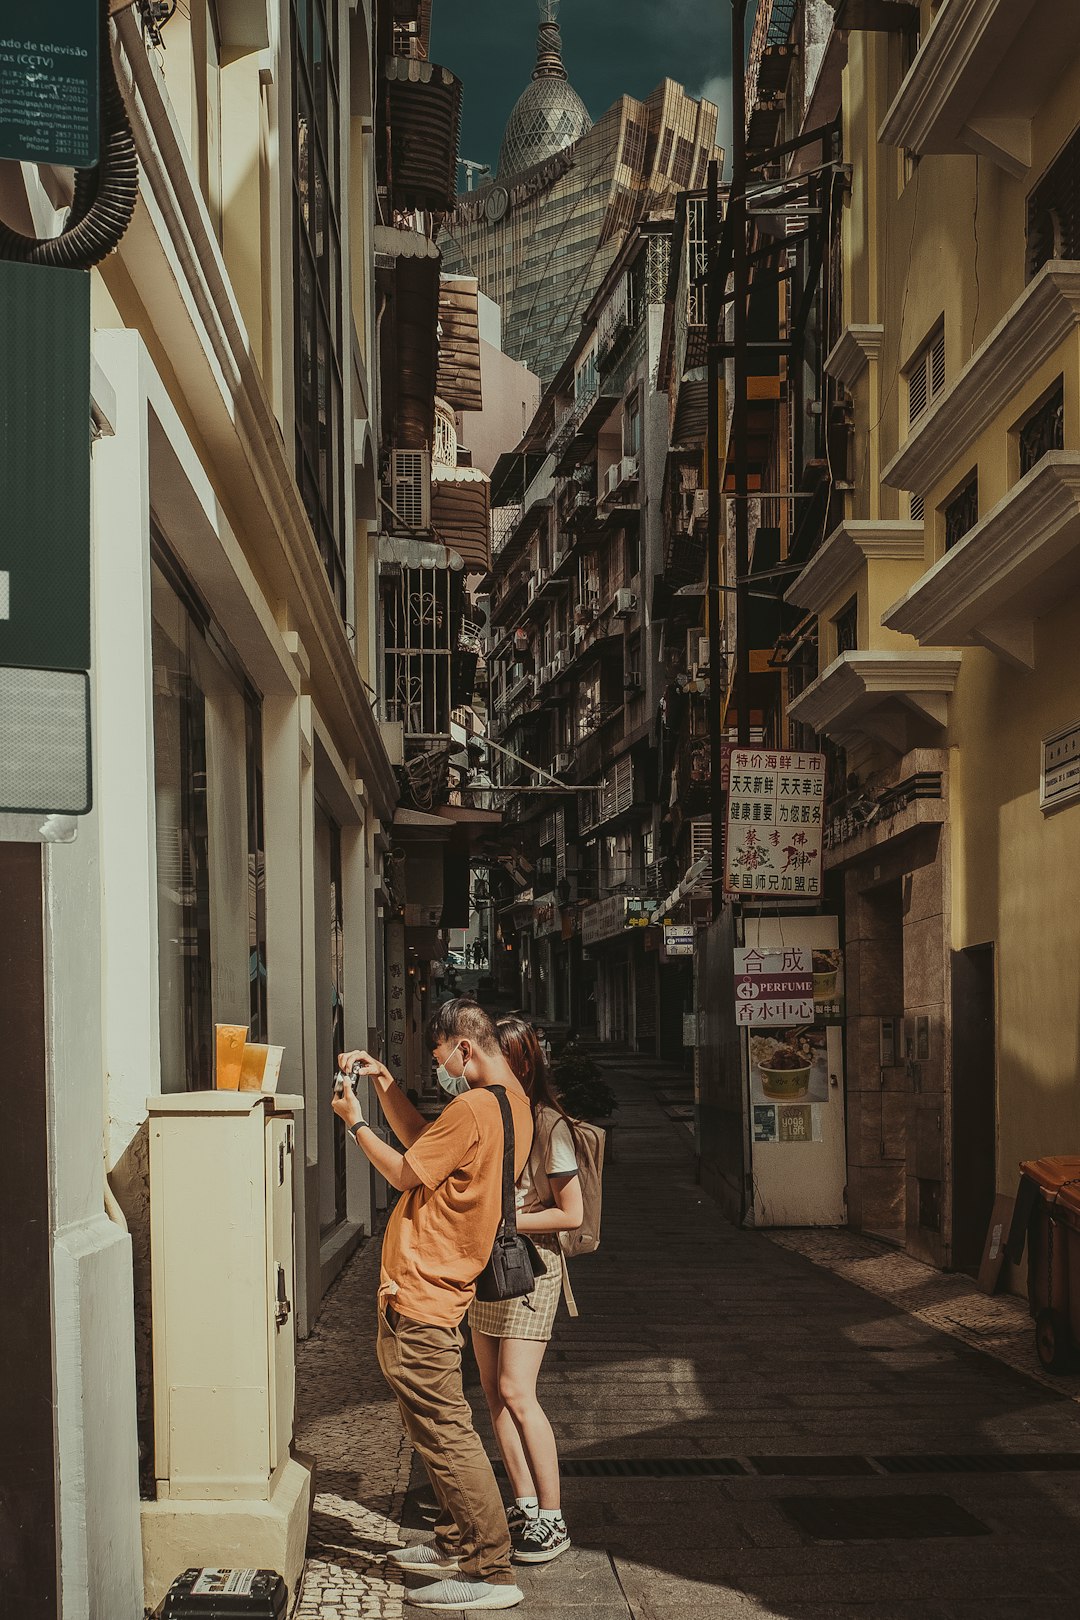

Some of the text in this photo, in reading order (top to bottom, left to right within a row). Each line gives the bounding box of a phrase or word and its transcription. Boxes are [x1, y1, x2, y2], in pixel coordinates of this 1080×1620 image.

[24, 40, 37, 50] de
[40, 43, 88, 57] televisão
[17, 54, 54, 68] (CCTV)
[18, 134, 49, 143] Telefone
[26, 143, 49, 151] Phone
[735, 753, 821, 771] 特价海鲜上市
[731, 775, 823, 796] 天天新鲜 天天幸运
[730, 802, 822, 824] 健康重要 为您服务
[728, 874, 819, 892] 美国师兄加盟店
[742, 948, 804, 973] 合成
[760, 982, 813, 992] PERFUME
[738, 1001, 813, 1021] 香水中心
[781, 1117, 804, 1128] yoga
